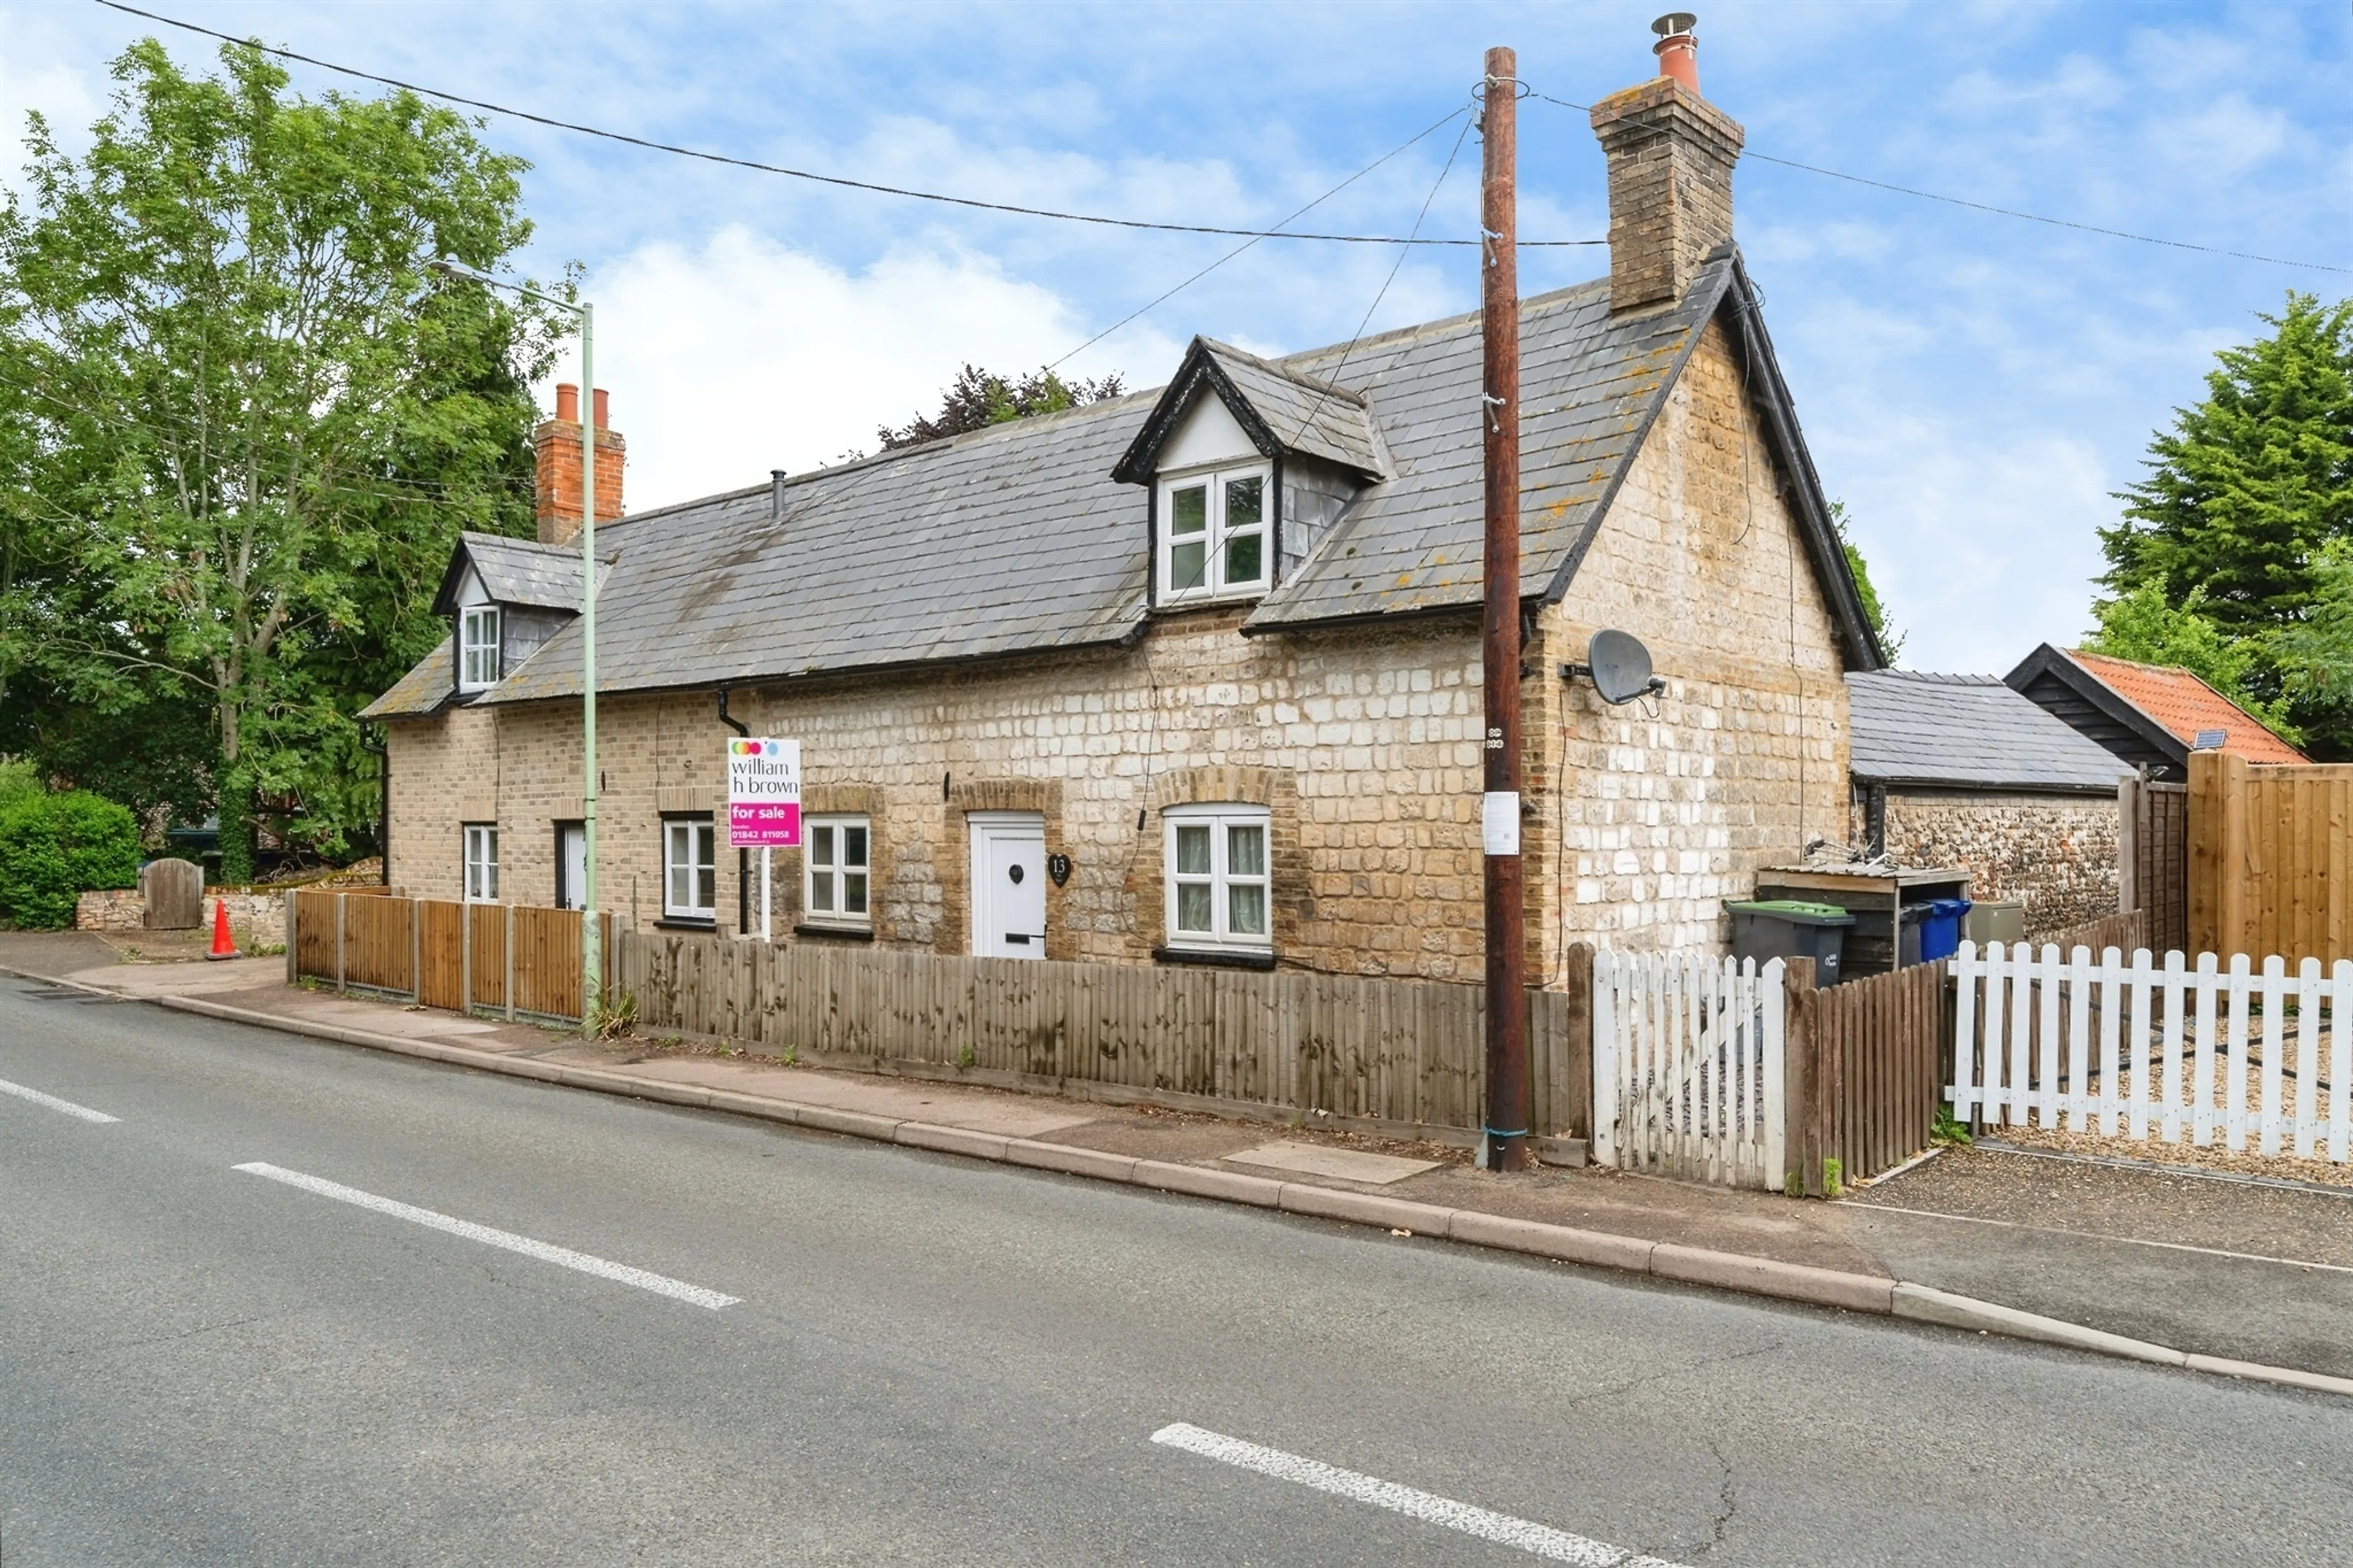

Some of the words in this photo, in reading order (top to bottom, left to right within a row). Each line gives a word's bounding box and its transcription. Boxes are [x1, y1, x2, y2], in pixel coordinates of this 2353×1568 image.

[732, 758, 789, 775] william
[734, 776, 743, 793] h
[749, 776, 798, 793] brown
[732, 806, 754, 819] for
[758, 806, 785, 819] sale
[1053, 859, 1065, 873] 13
